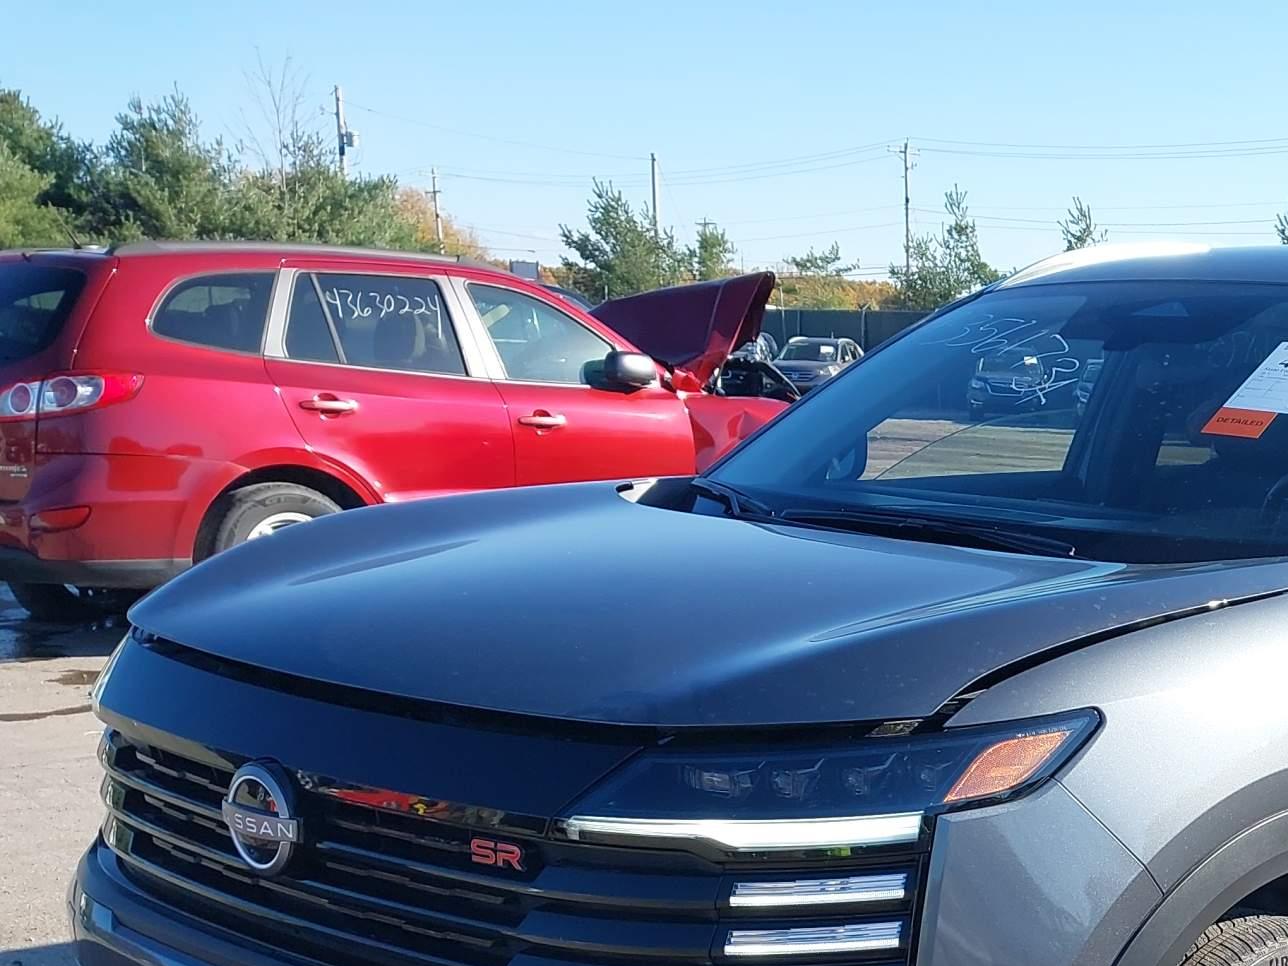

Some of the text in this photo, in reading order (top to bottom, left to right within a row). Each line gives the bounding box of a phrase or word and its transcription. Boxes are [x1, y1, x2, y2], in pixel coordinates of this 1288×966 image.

[325, 288, 441, 339] 43630224
[1216, 416, 1263, 427] DETAILED
[230, 811, 294, 838] SSAN
[470, 838, 522, 871] SR
